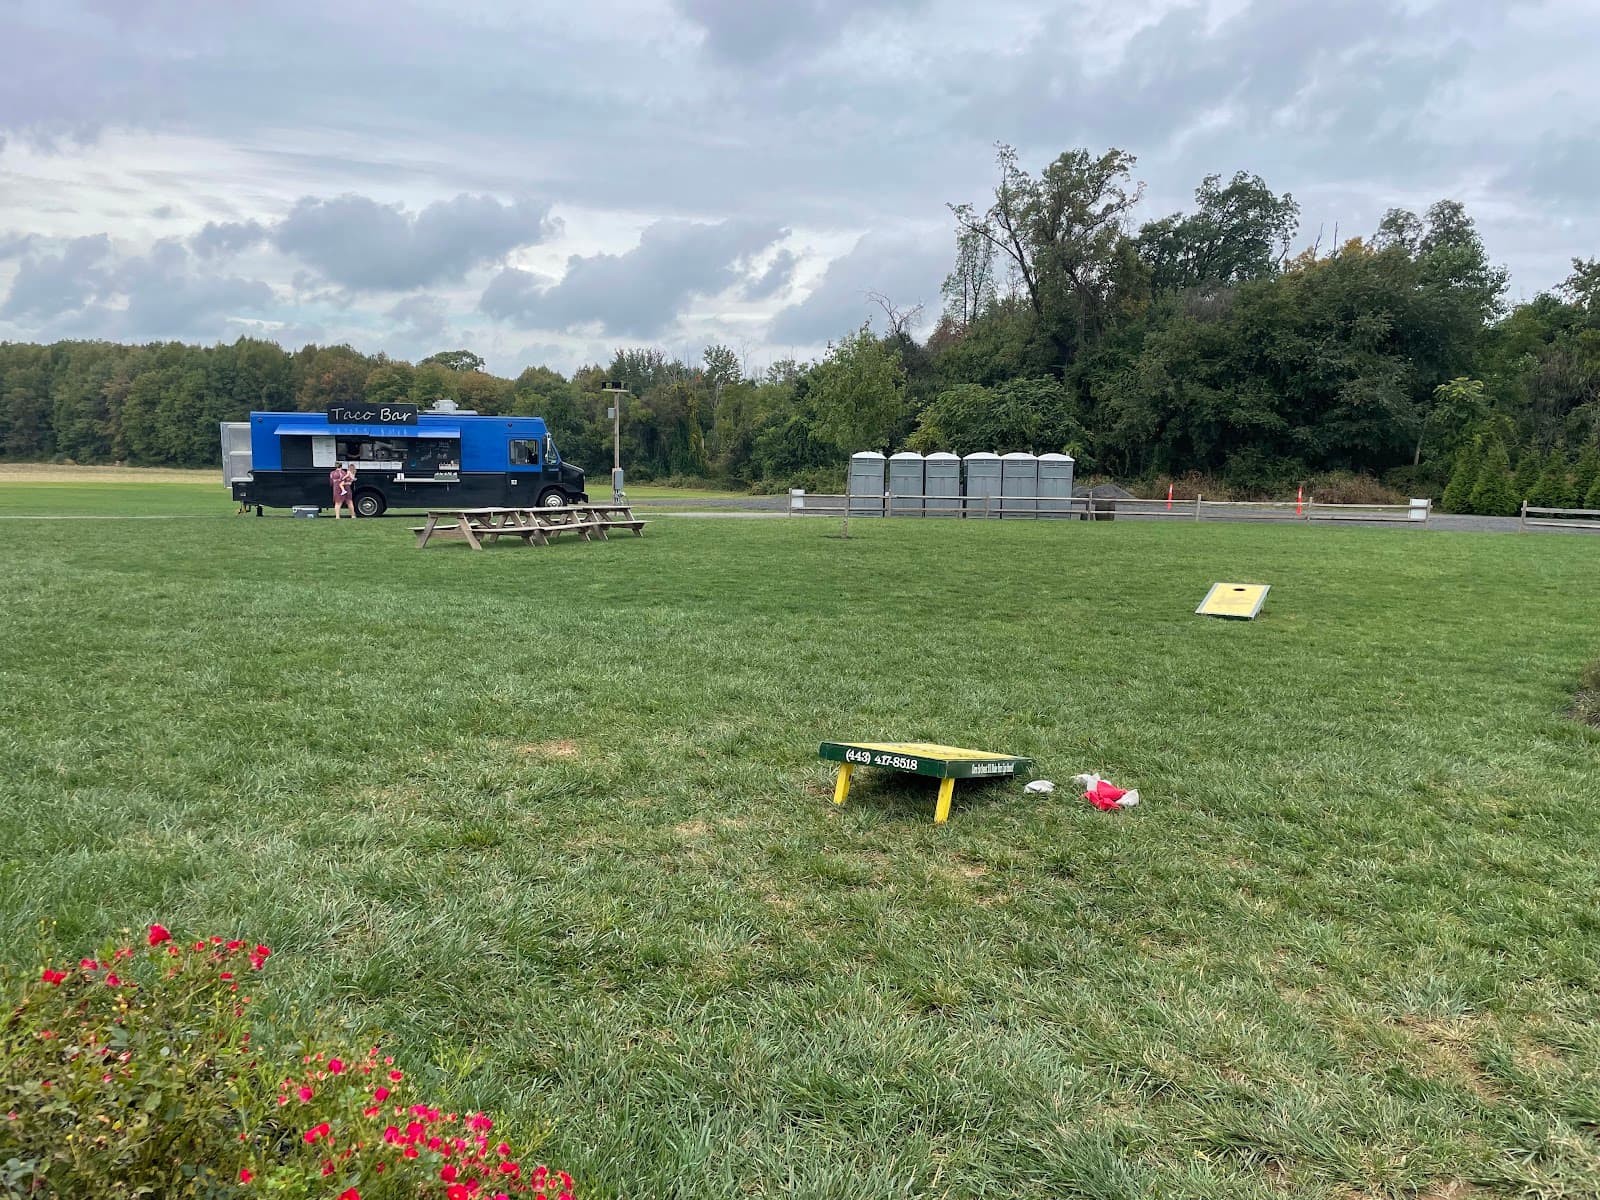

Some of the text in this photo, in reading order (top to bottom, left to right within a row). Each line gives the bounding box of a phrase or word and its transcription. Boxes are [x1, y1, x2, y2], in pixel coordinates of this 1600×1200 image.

[331, 408, 412, 421] Taco Bar
[846, 749, 918, 770] (443) 417-8518
